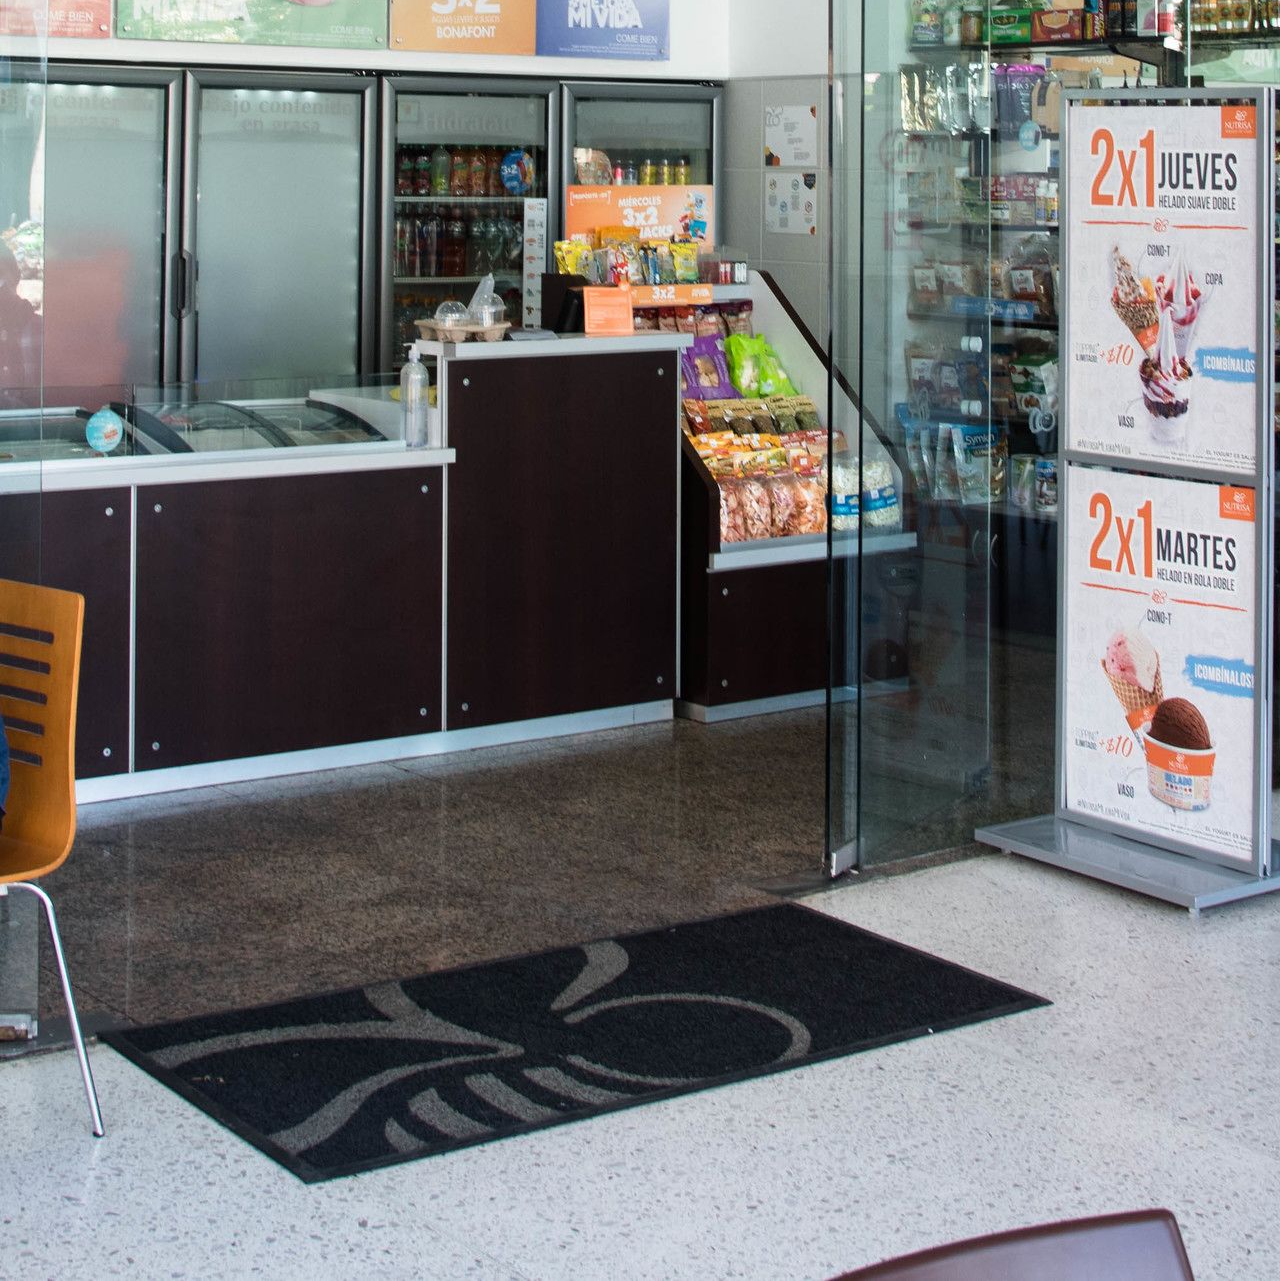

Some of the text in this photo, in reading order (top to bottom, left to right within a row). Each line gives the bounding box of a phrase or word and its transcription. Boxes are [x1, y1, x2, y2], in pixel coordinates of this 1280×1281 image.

[436, 25, 497, 39] BONAFONT
[1090, 128, 1155, 207] 2x1
[1157, 152, 1238, 192] JUEVES
[1158, 194, 1236, 212] HELADO SUAVE DOBLE
[622, 206, 658, 227] 3x2
[1147, 244, 1171, 257] CONO-T
[1205, 272, 1223, 286] COPA
[1118, 414, 1135, 429] VASO
[1089, 492, 1154, 578] 2x1
[1156, 528, 1237, 572] MARTES
[1156, 568, 1235, 592] HELADO EN BOLA DOBLE
[1146, 609, 1172, 626] CONO-T
[1117, 782, 1135, 799] VASO
